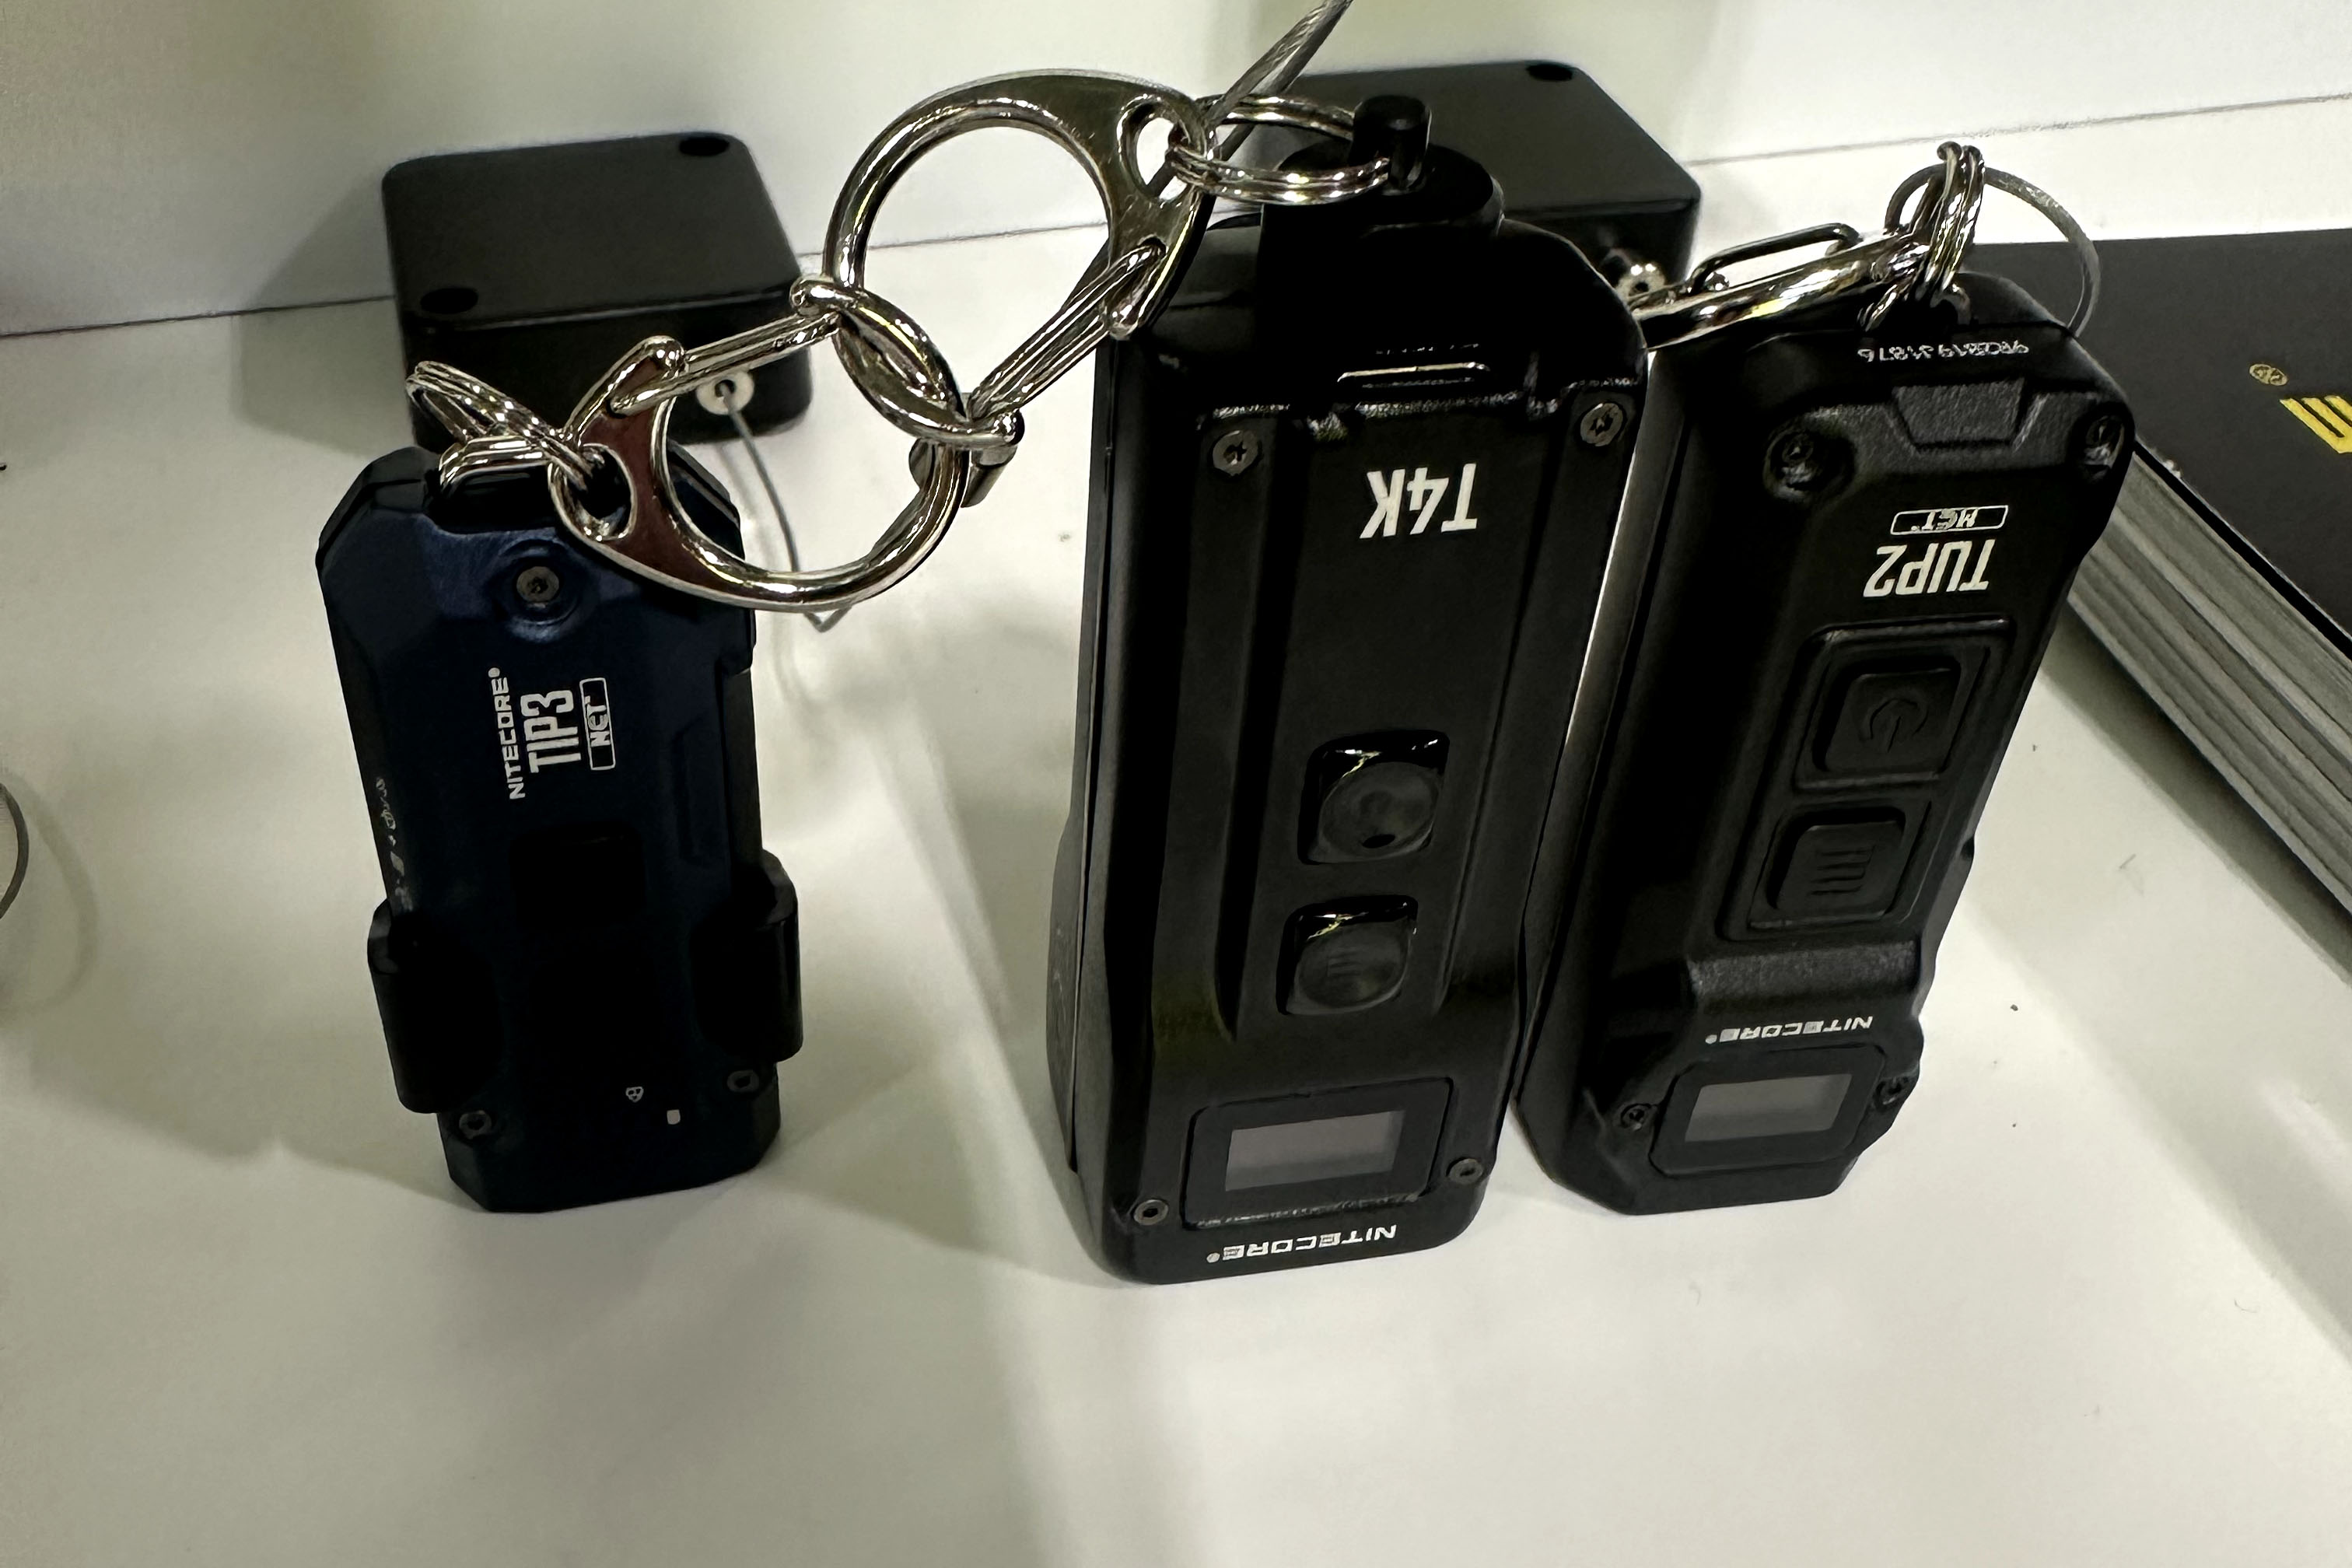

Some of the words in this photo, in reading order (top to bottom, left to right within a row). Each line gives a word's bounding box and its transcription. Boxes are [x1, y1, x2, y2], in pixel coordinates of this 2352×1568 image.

[1359, 463, 1478, 539] T4K
[1863, 538, 1996, 598] TUP2
[490, 677, 526, 800] NITECORE
[520, 689, 582, 774] TIP3
[1718, 1015, 1874, 1043] NITECORE
[1222, 1223, 1398, 1262] NITECORE
